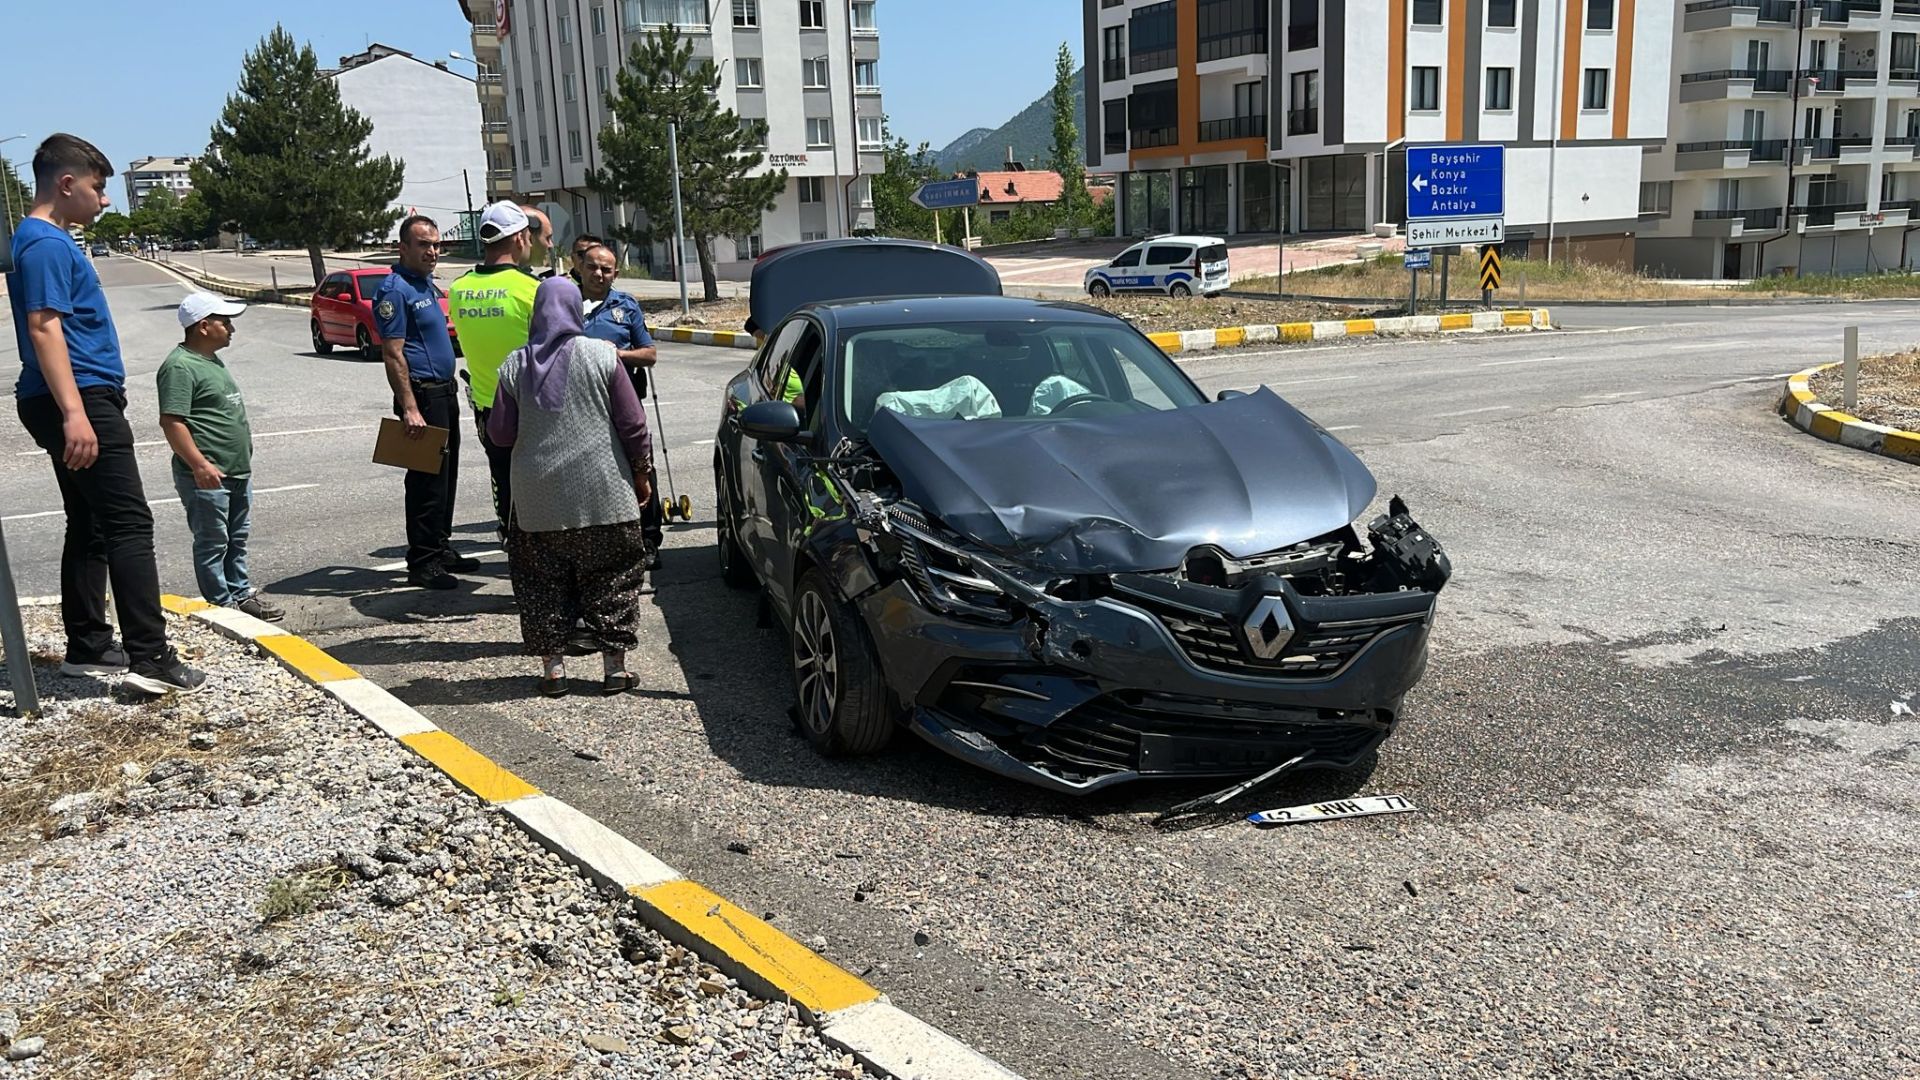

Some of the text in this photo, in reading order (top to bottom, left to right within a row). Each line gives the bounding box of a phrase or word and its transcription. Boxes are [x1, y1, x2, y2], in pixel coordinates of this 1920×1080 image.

[1431, 153, 1480, 165] Beyşehir
[1431, 169, 1466, 181] Konya
[1431, 184, 1468, 195] Bozkır
[1431, 199, 1476, 211] Antalya
[1412, 226, 1488, 240] Şehir Merkezi
[1313, 801, 1364, 816] HVH
[1375, 796, 1408, 809] 77
